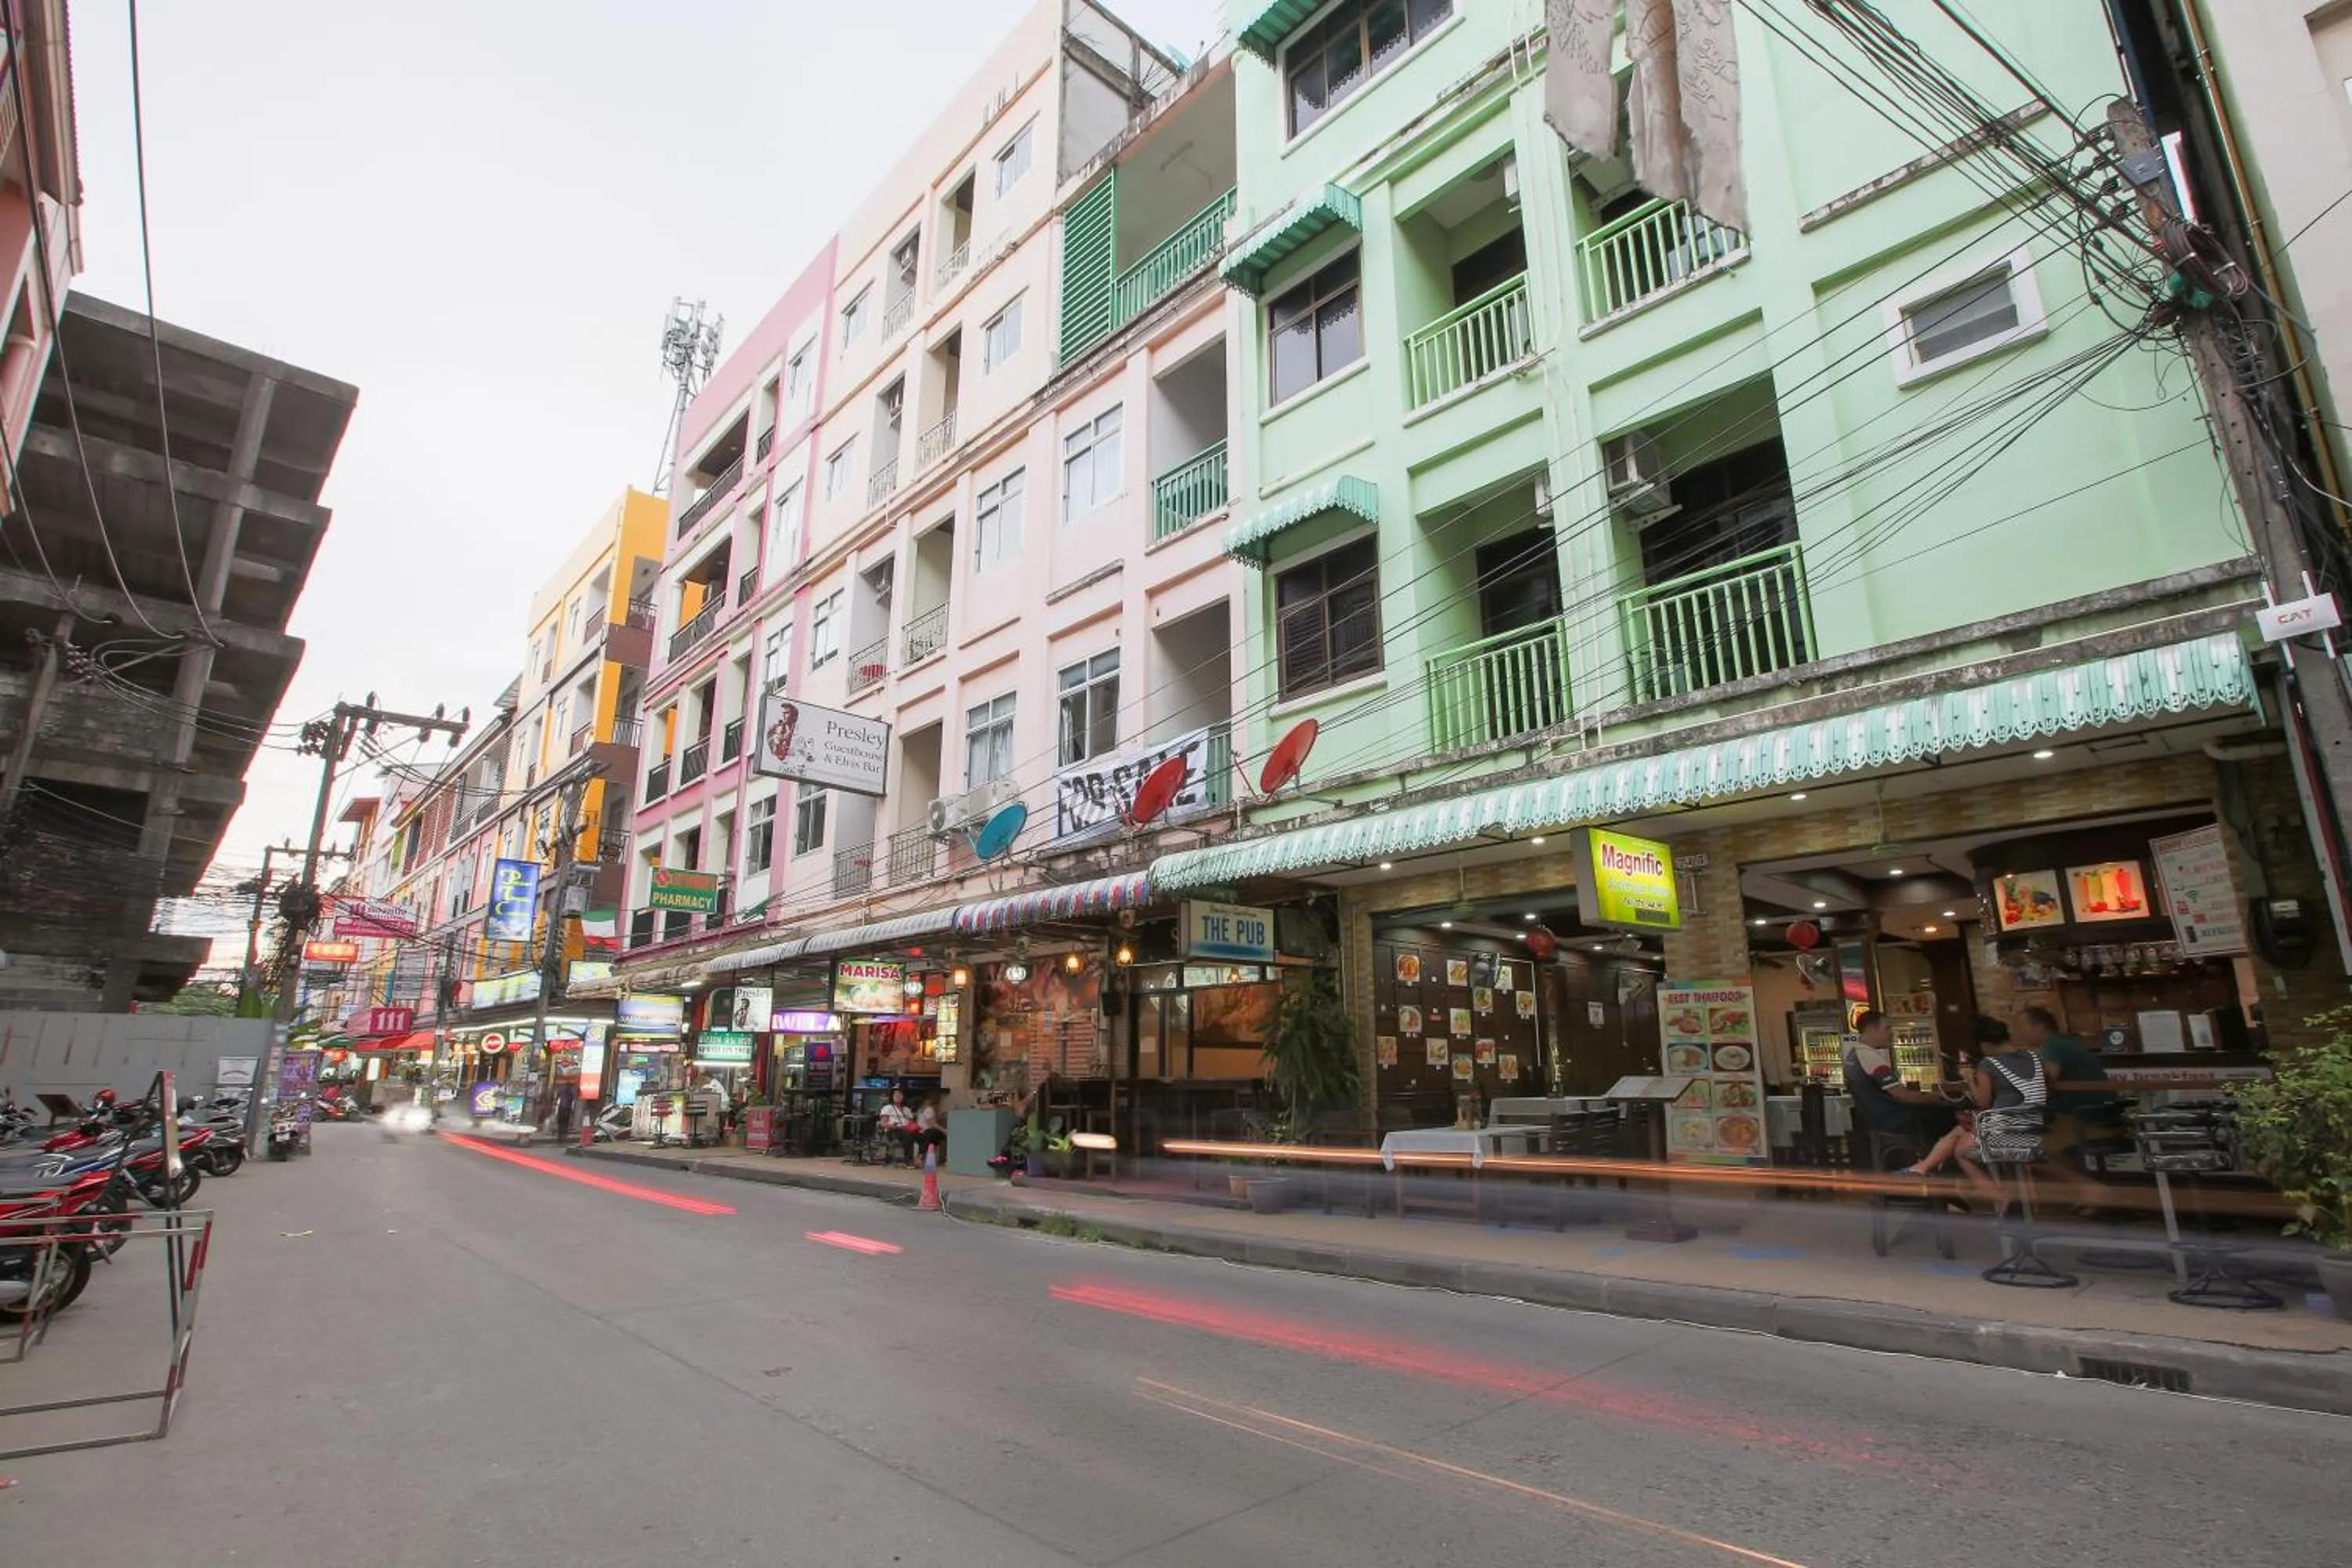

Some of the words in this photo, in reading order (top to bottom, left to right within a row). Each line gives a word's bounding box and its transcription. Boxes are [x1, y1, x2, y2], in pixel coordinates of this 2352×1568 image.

[2278, 608, 2312, 624] CAT
[826, 720, 885, 750] Presley
[824, 740, 884, 762] Guesthouse
[823, 753, 833, 764] &
[835, 756, 861, 769] Elvis
[862, 760, 882, 774] Bar
[1112, 741, 1200, 823] SE
[1601, 843, 1664, 877] Magnific
[652, 891, 713, 909] PHARMACY
[1202, 915, 1230, 942] THE
[1236, 919, 1265, 946] PUB
[840, 964, 901, 979] MARISA
[1667, 993, 1690, 1004] BEST
[376, 1011, 405, 1030] 111
